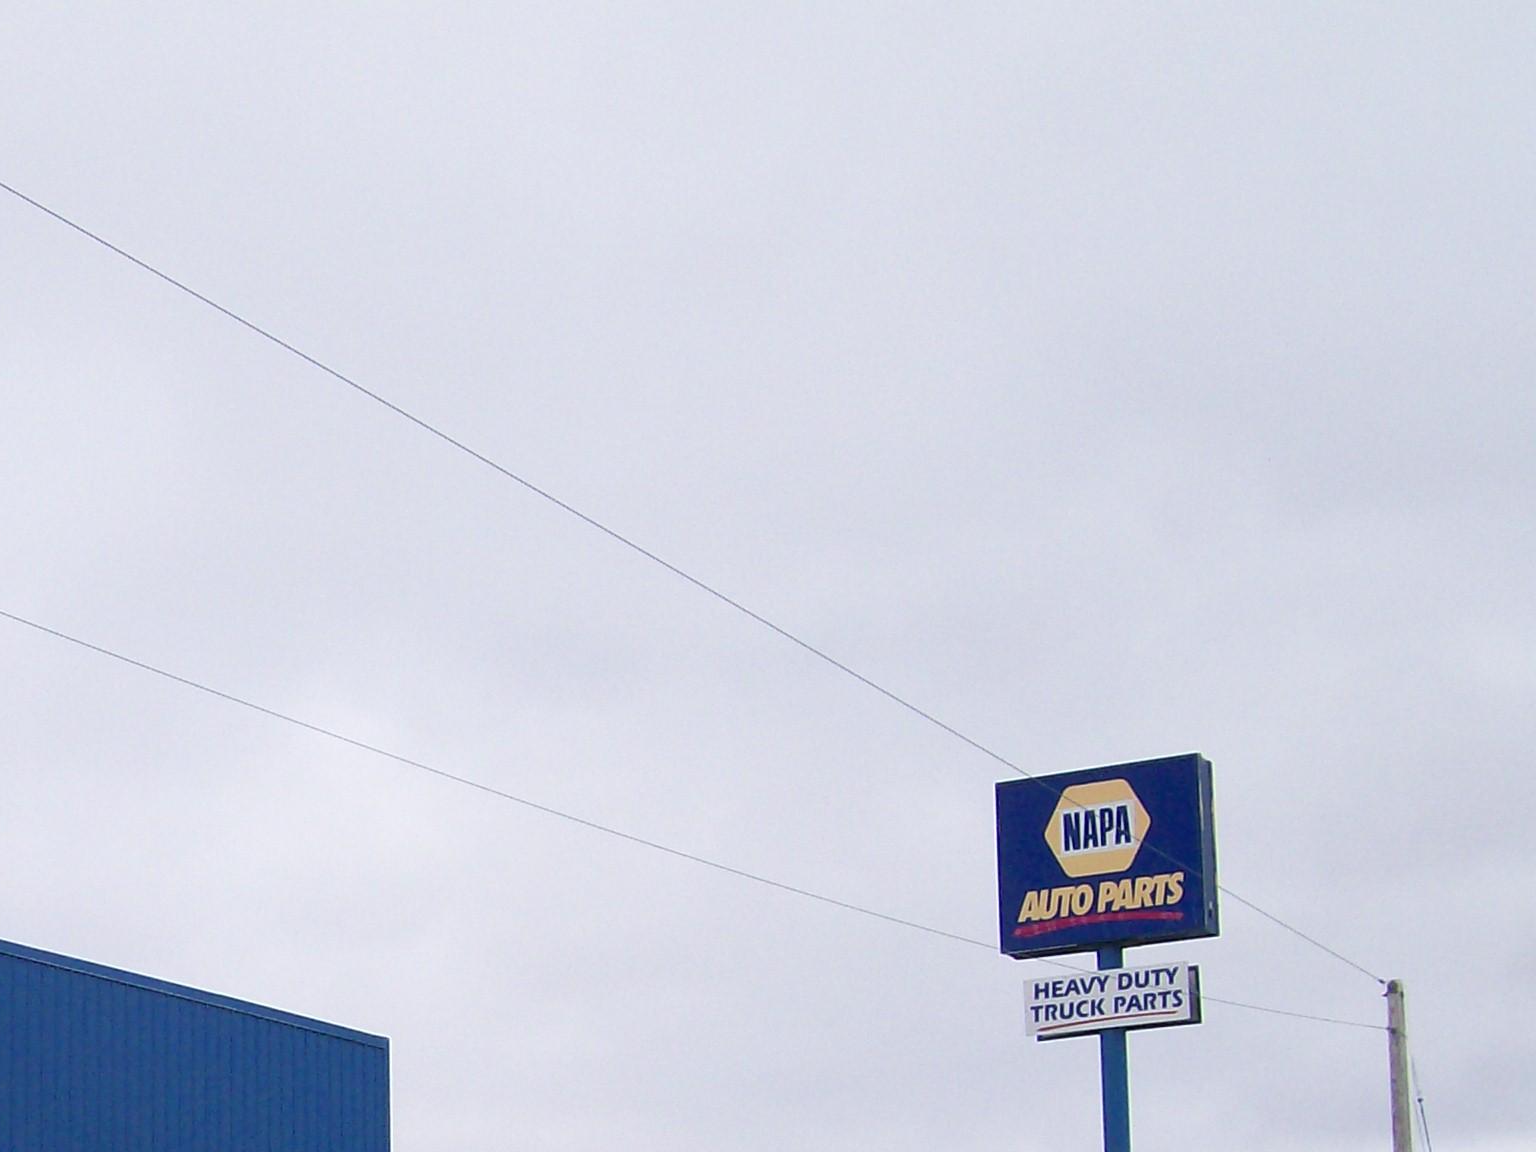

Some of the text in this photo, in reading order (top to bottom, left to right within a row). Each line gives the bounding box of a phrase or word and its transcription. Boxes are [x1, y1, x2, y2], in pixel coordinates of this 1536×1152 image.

[1063, 805, 1131, 851] NAPA
[1017, 871, 1184, 923] AUTO PARTS
[1033, 966, 1180, 1000] HEAVY DUTY
[1030, 989, 1184, 1023] TRUCK PARTS
